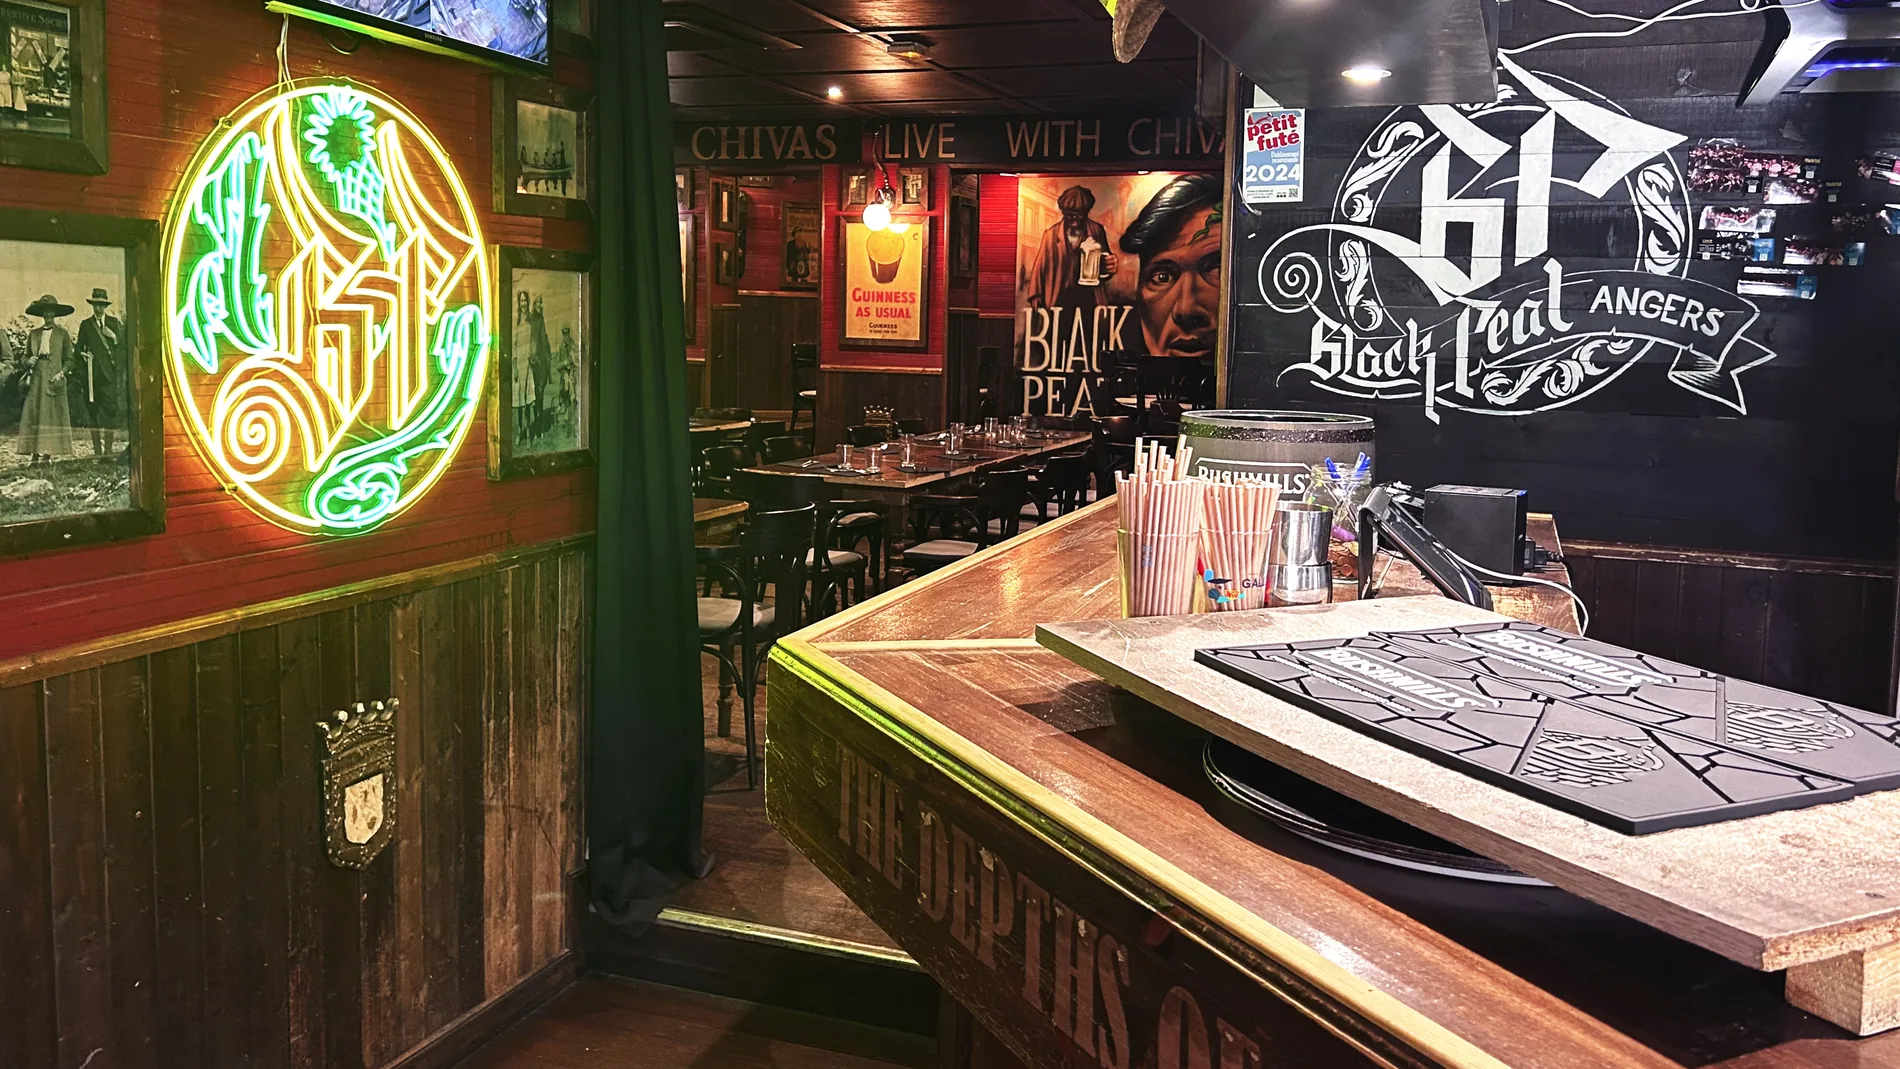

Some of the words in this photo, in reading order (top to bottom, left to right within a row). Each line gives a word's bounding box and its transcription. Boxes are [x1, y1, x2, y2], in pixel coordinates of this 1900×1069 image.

[691, 124, 837, 160] CHIVAS
[884, 123, 955, 160] LIVE
[1006, 119, 1100, 158] WITH
[1128, 117, 1226, 155] CHIV
[1247, 114, 1297, 141] petit
[1257, 129, 1300, 151] futé
[1245, 164, 1300, 182] 2024
[852, 287, 916, 304] GUINNESS
[855, 306, 871, 318] AS
[876, 307, 912, 319] USUAL
[1589, 285, 1725, 336] ANGERS
[1021, 305, 1134, 373] BLACK
[1277, 312, 1441, 425] Black
[1021, 375, 1104, 419] PEA
[836, 743, 904, 891] THE
[917, 799, 1131, 1069] DEPTHS
